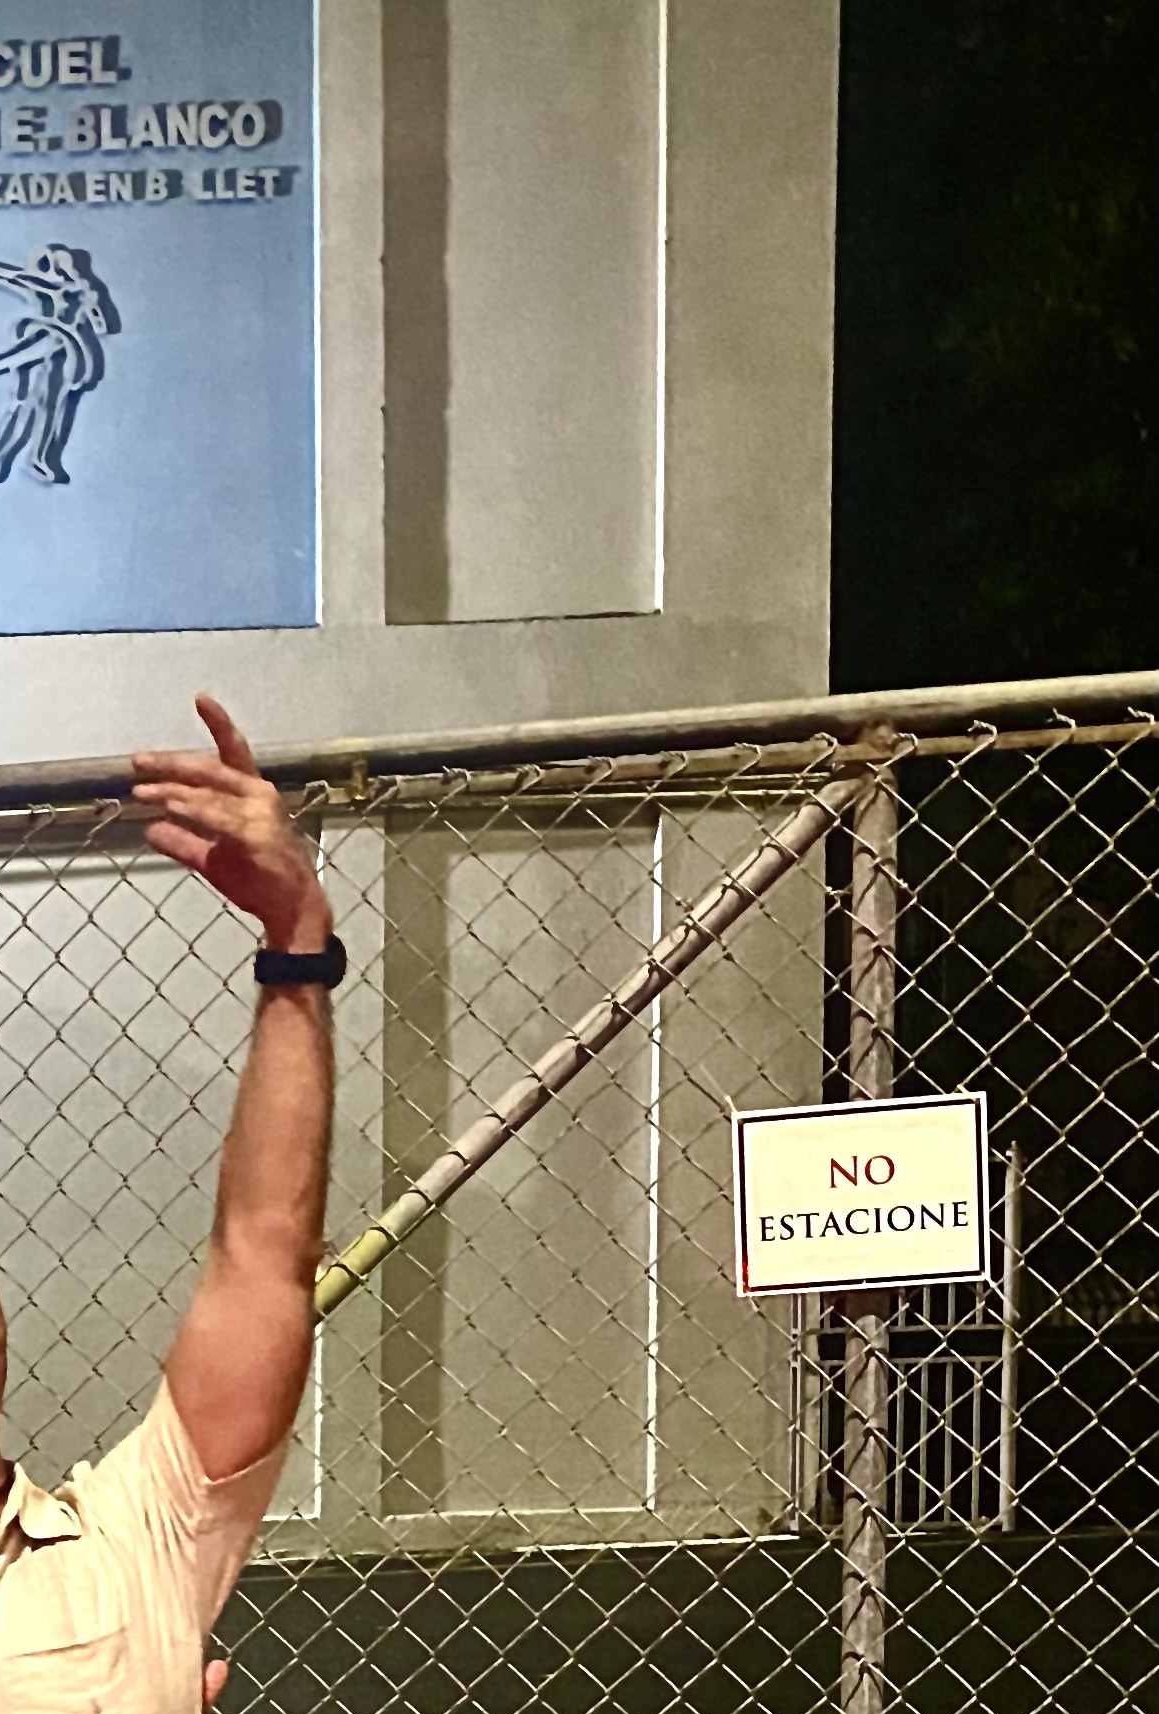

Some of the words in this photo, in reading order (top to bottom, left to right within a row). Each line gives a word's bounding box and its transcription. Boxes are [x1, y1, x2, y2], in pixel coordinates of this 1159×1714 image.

[69, 102, 267, 151] BLANCO
[85, 170, 134, 203] EN
[829, 1154, 895, 1189] NO
[759, 1200, 969, 1242] ESTACIONE
